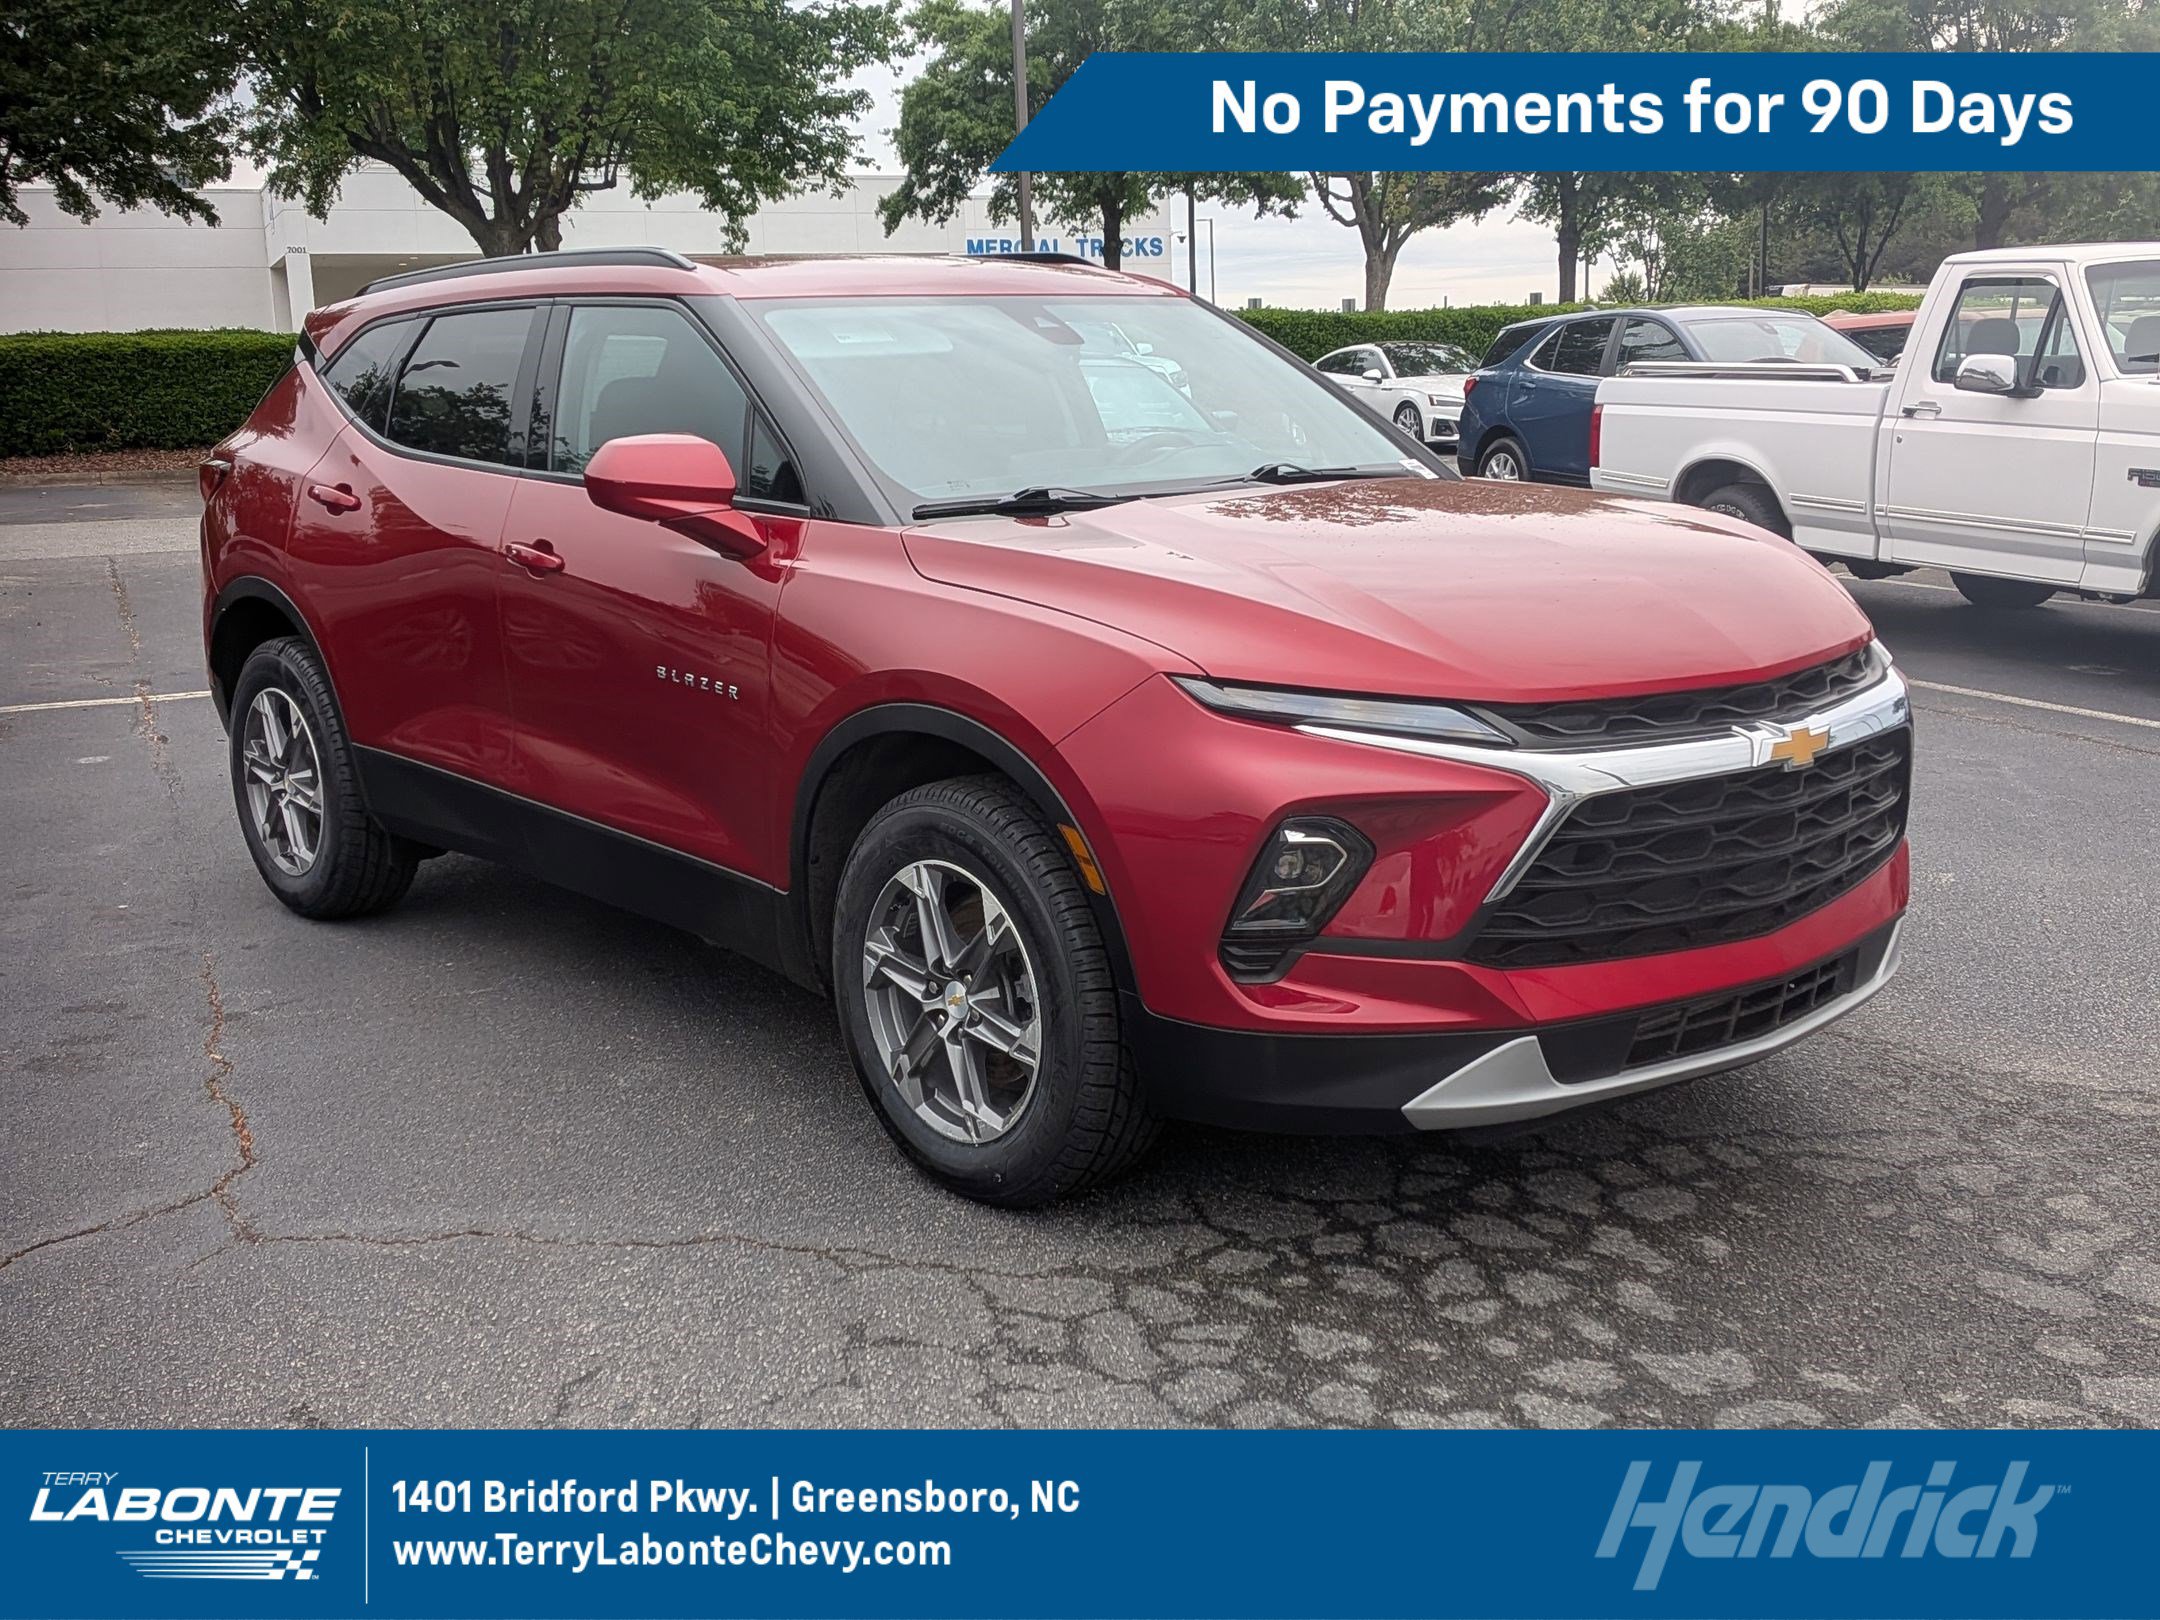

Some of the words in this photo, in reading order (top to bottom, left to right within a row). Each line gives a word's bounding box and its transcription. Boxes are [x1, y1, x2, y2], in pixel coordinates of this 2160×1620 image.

[286, 246, 307, 254] 7001
[1075, 237, 1164, 257] TRCKS
[656, 665, 739, 700] BLAZER
